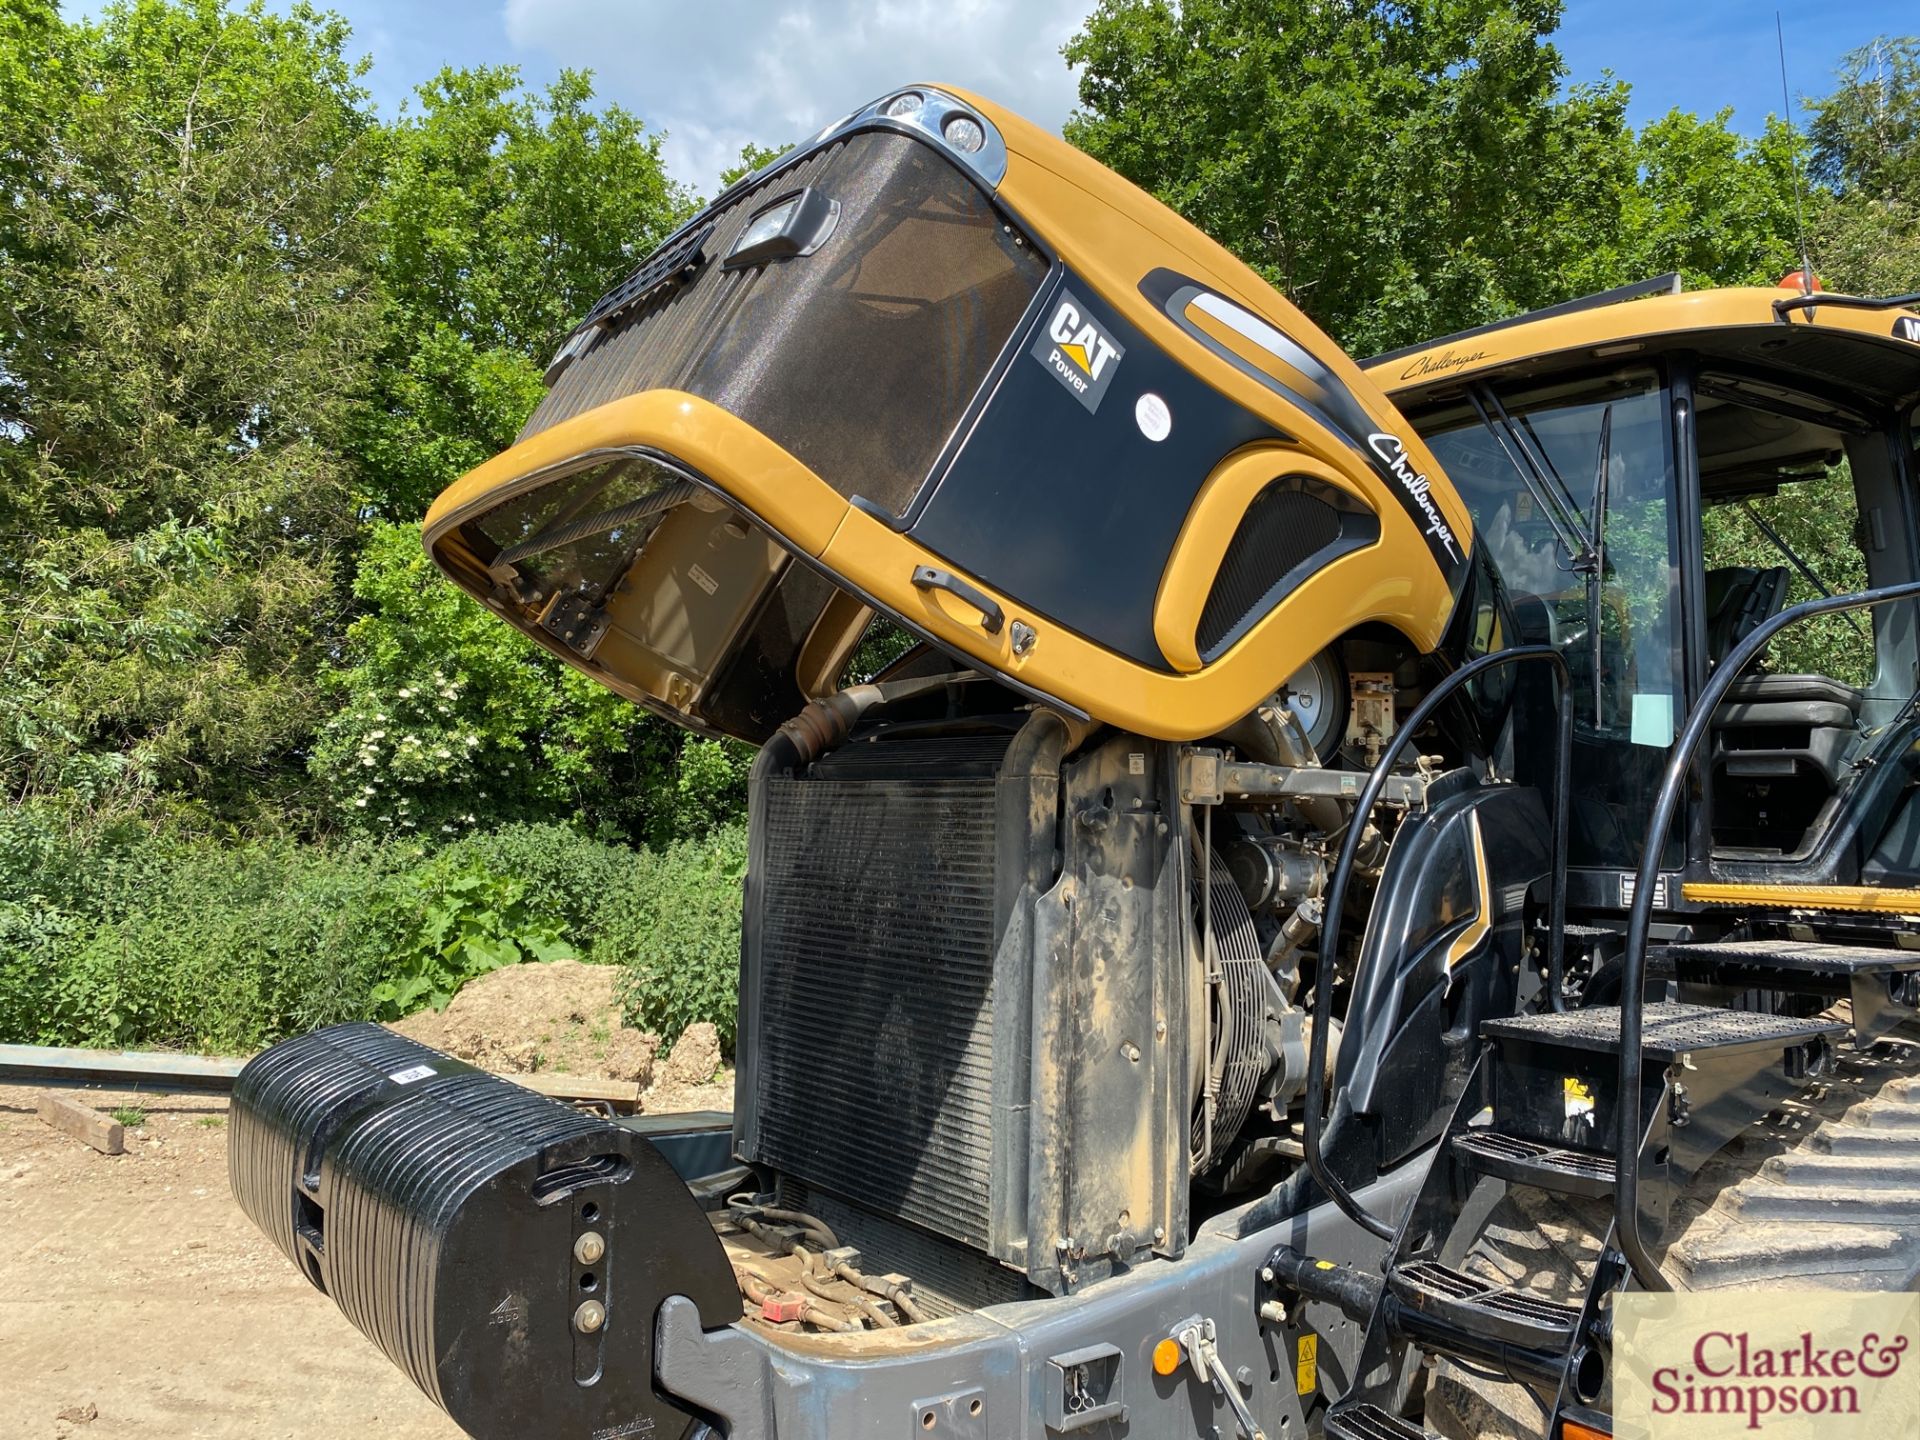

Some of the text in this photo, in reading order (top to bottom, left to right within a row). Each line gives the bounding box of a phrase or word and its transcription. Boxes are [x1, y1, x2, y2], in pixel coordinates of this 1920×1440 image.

[1048, 349, 1088, 393] Power
[1049, 302, 1117, 381] CAT
[1400, 350, 1498, 381] Challenger
[1367, 433, 1459, 565] Challenger
